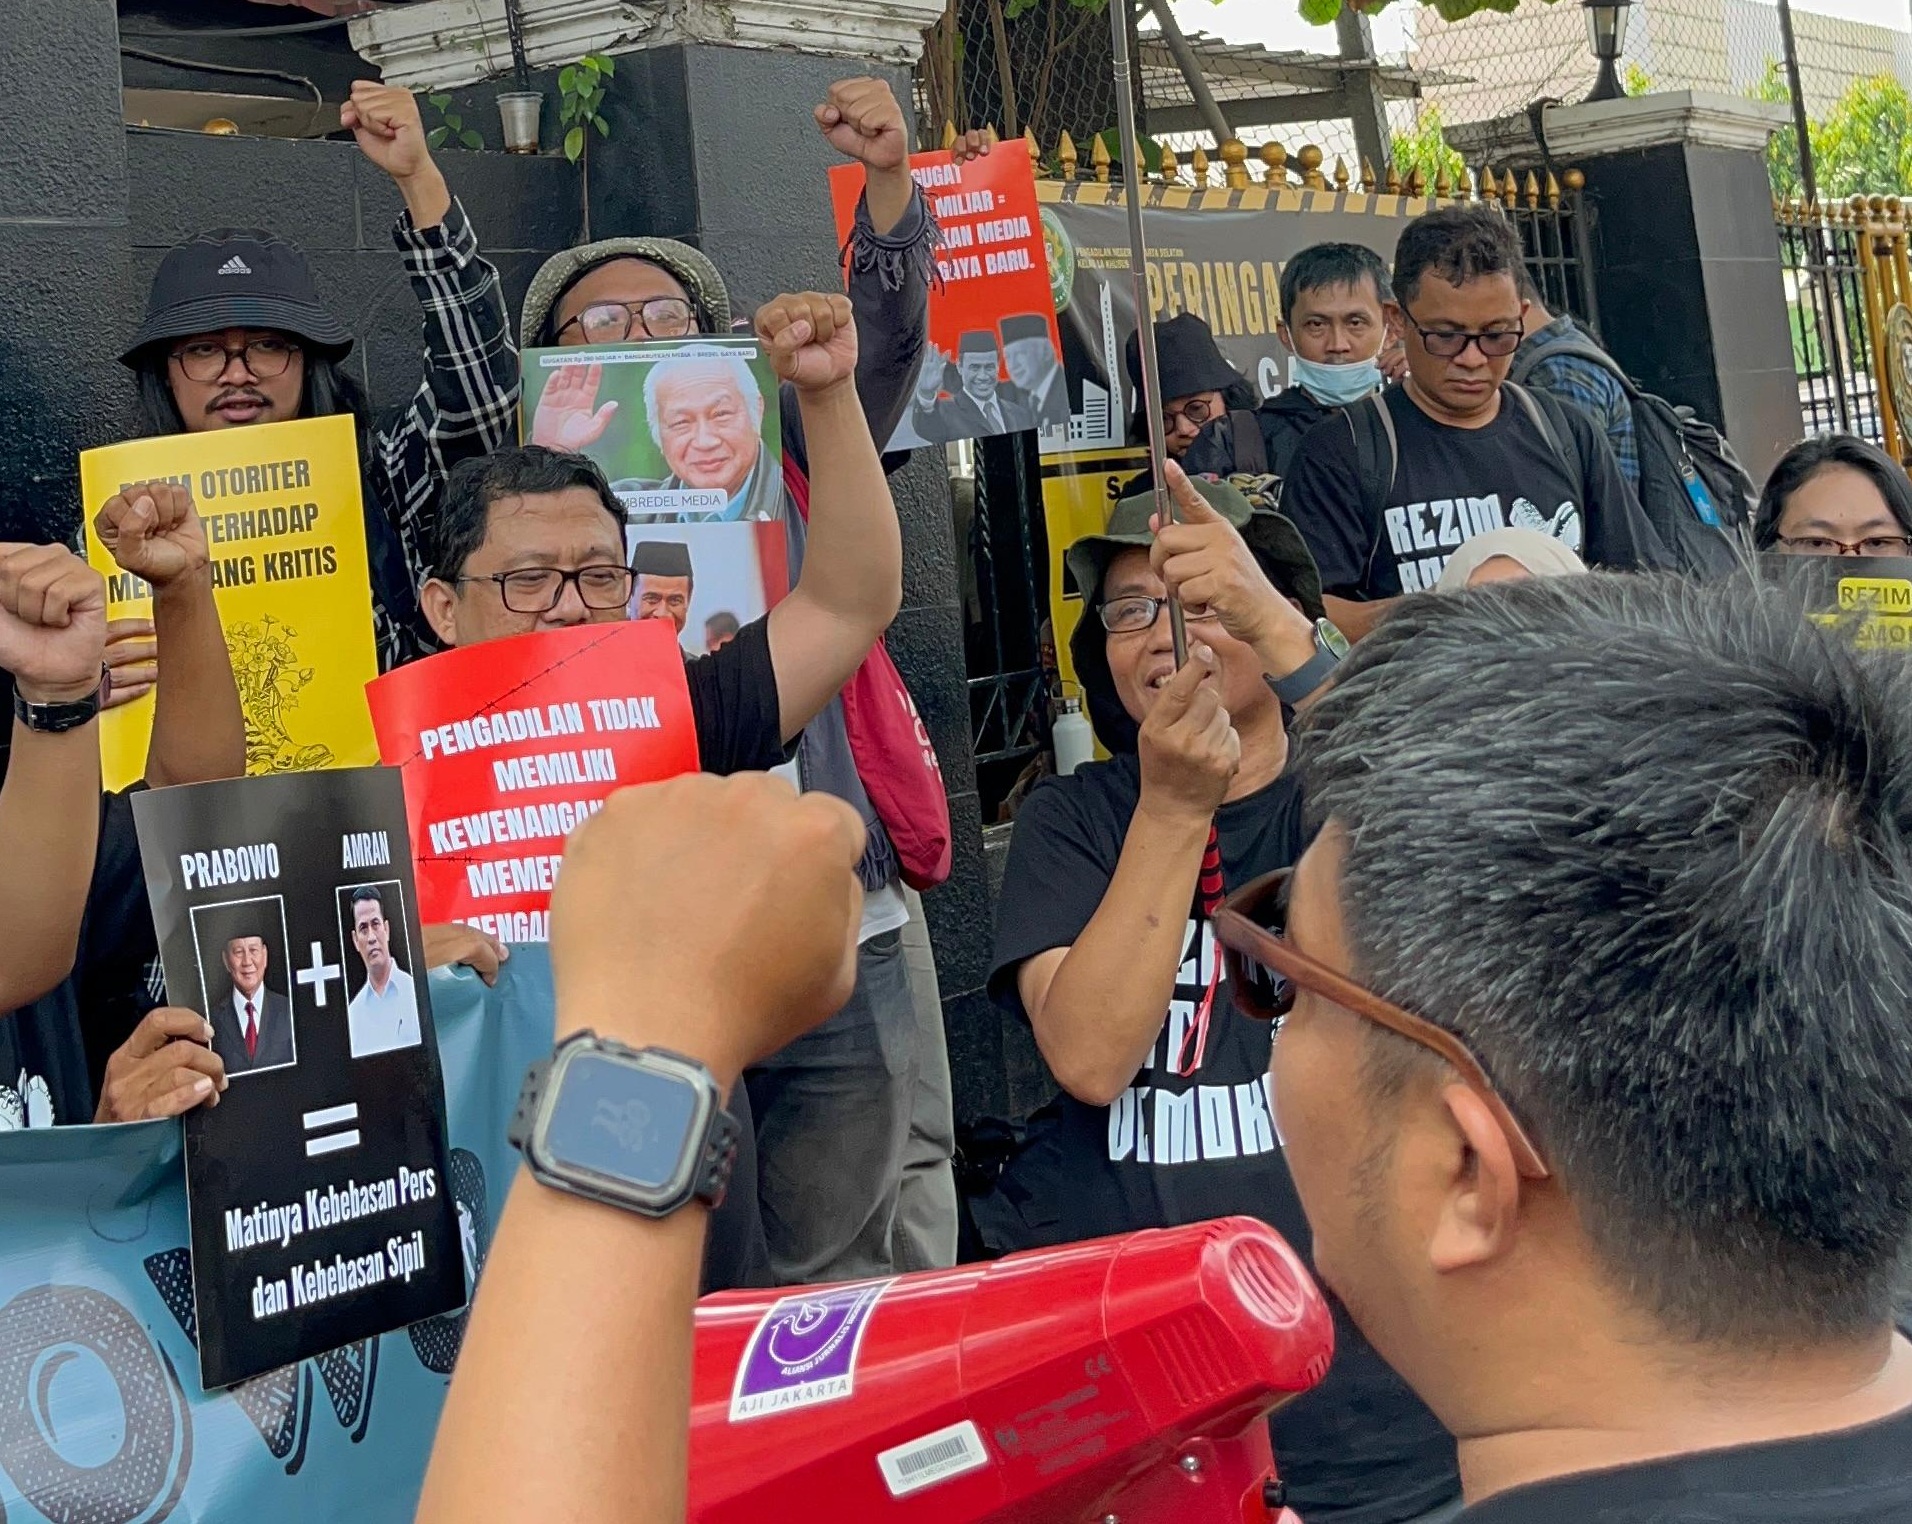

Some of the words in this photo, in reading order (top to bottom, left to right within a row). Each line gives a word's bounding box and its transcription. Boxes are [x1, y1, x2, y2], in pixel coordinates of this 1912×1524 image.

[910, 163, 962, 190] GUGAT
[935, 189, 995, 219] MILIAR
[976, 215, 1032, 245] MEDIA
[936, 255, 983, 283] GAYA
[984, 247, 1036, 276] BARU.
[1144, 261, 1287, 336] PERINGA
[201, 459, 311, 500] OTORITER
[682, 494, 721, 506] MEDIA
[1384, 493, 1505, 555] REZIM
[264, 545, 338, 583] KRITIS
[1841, 586, 1912, 606] REZIM
[420, 702, 585, 760] PENGADILAN
[587, 696, 661, 732] TIDAK
[493, 748, 617, 792] MEMILIKI
[180, 843, 280, 890] PRABOWO
[342, 831, 391, 869] AMRAN
[225, 1200, 303, 1252] Matinya
[305, 1178, 397, 1230] Kebebasan
[398, 1165, 436, 1204] Pers
[252, 1275, 288, 1319] dan
[290, 1251, 385, 1307] Kebebasan
[387, 1230, 425, 1283] Sipil
[738, 1397, 764, 1414] AJI
[771, 1379, 847, 1408] JAKARTA
